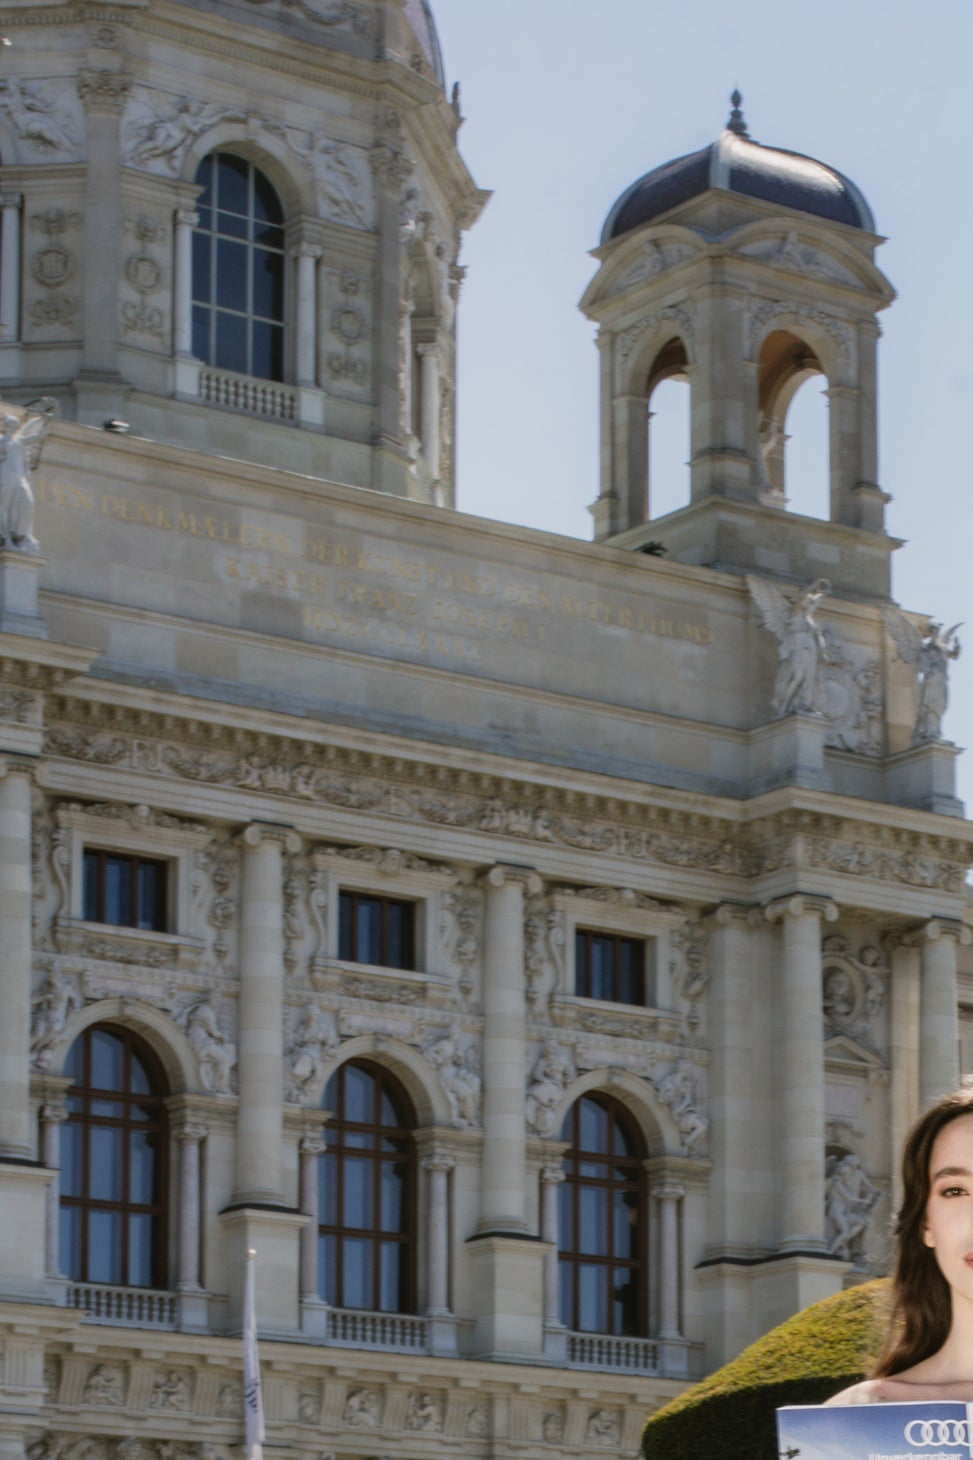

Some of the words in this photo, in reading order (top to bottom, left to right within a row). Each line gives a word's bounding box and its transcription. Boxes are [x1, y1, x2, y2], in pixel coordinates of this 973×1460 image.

[36, 480, 92, 510] DEN
[301, 539, 349, 567] DER
[225, 556, 325, 596] KAISER
[336, 578, 417, 617] FRANZ
